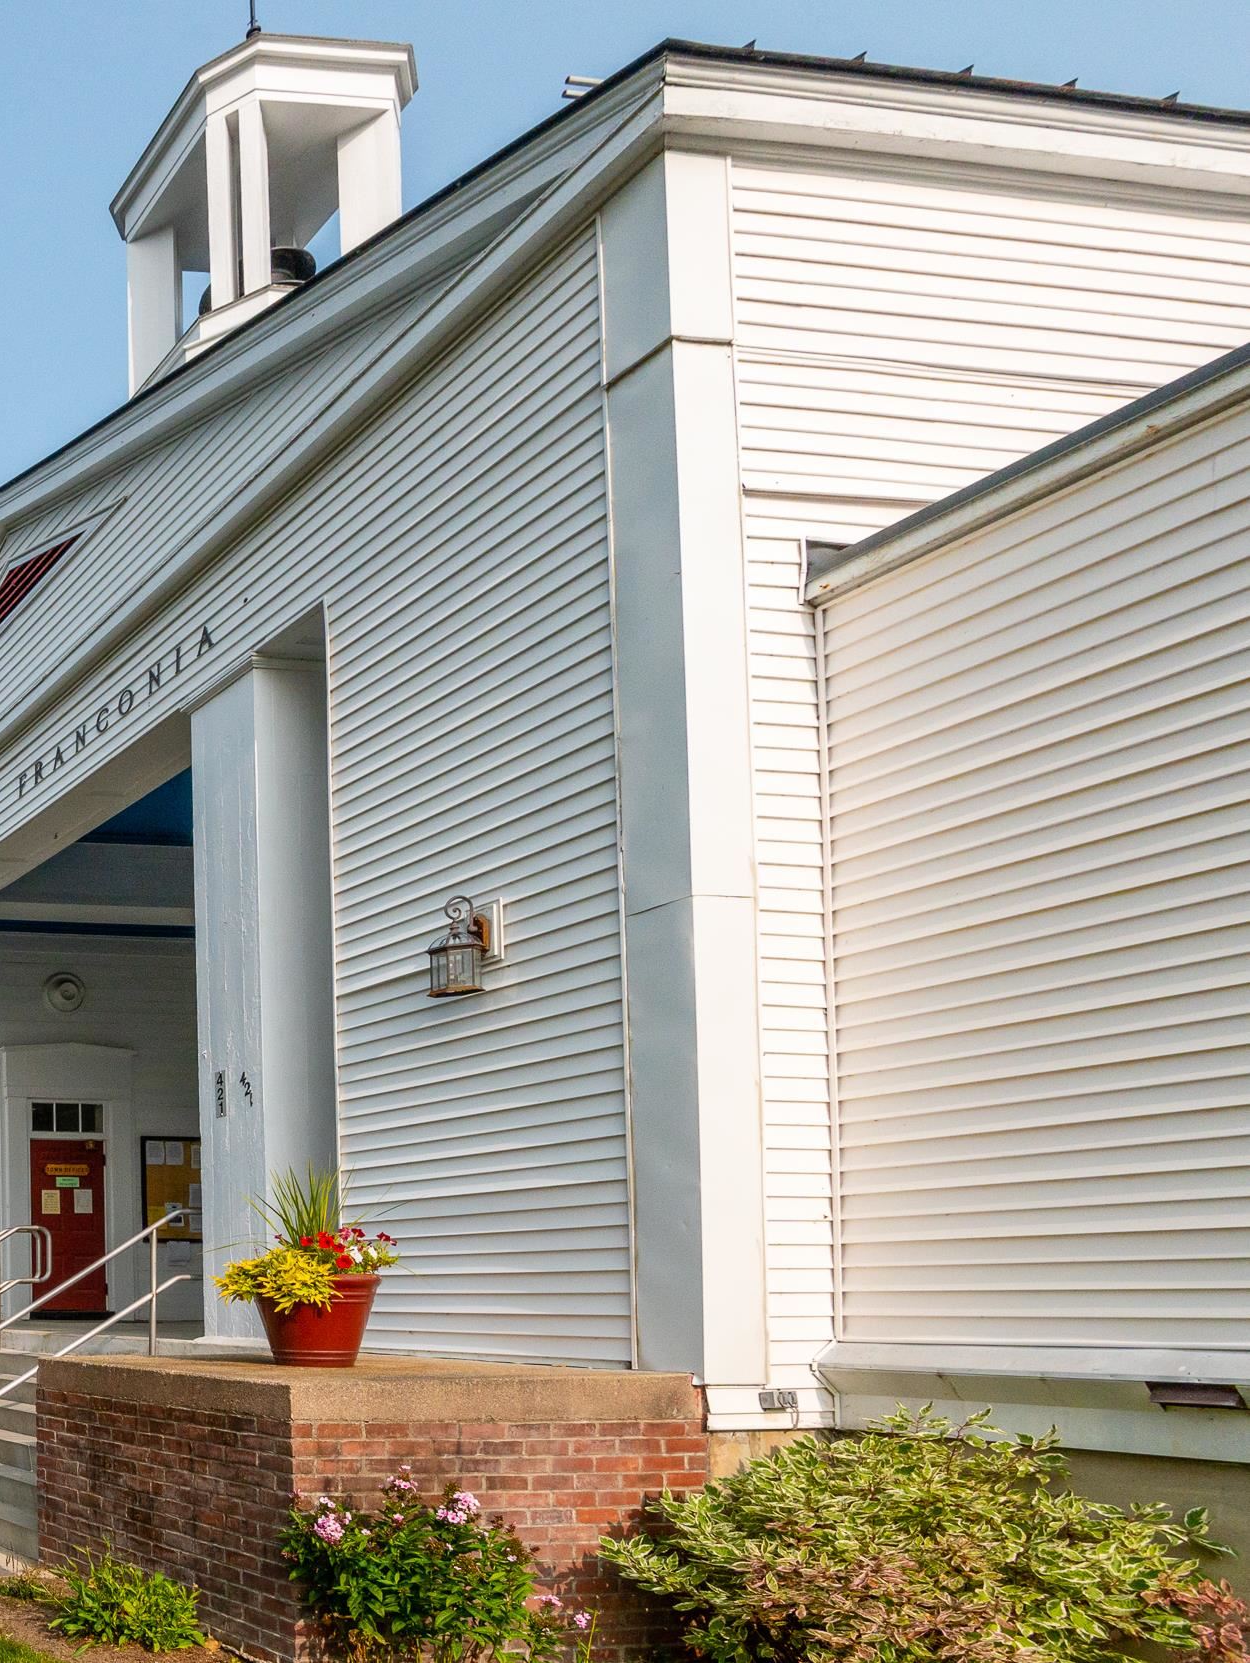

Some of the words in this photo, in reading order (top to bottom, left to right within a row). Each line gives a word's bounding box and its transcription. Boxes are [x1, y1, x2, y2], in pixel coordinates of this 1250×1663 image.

[17, 625, 215, 800] FRANCONIA
[216, 1072, 224, 1114] 421
[239, 1071, 253, 1107] 421
